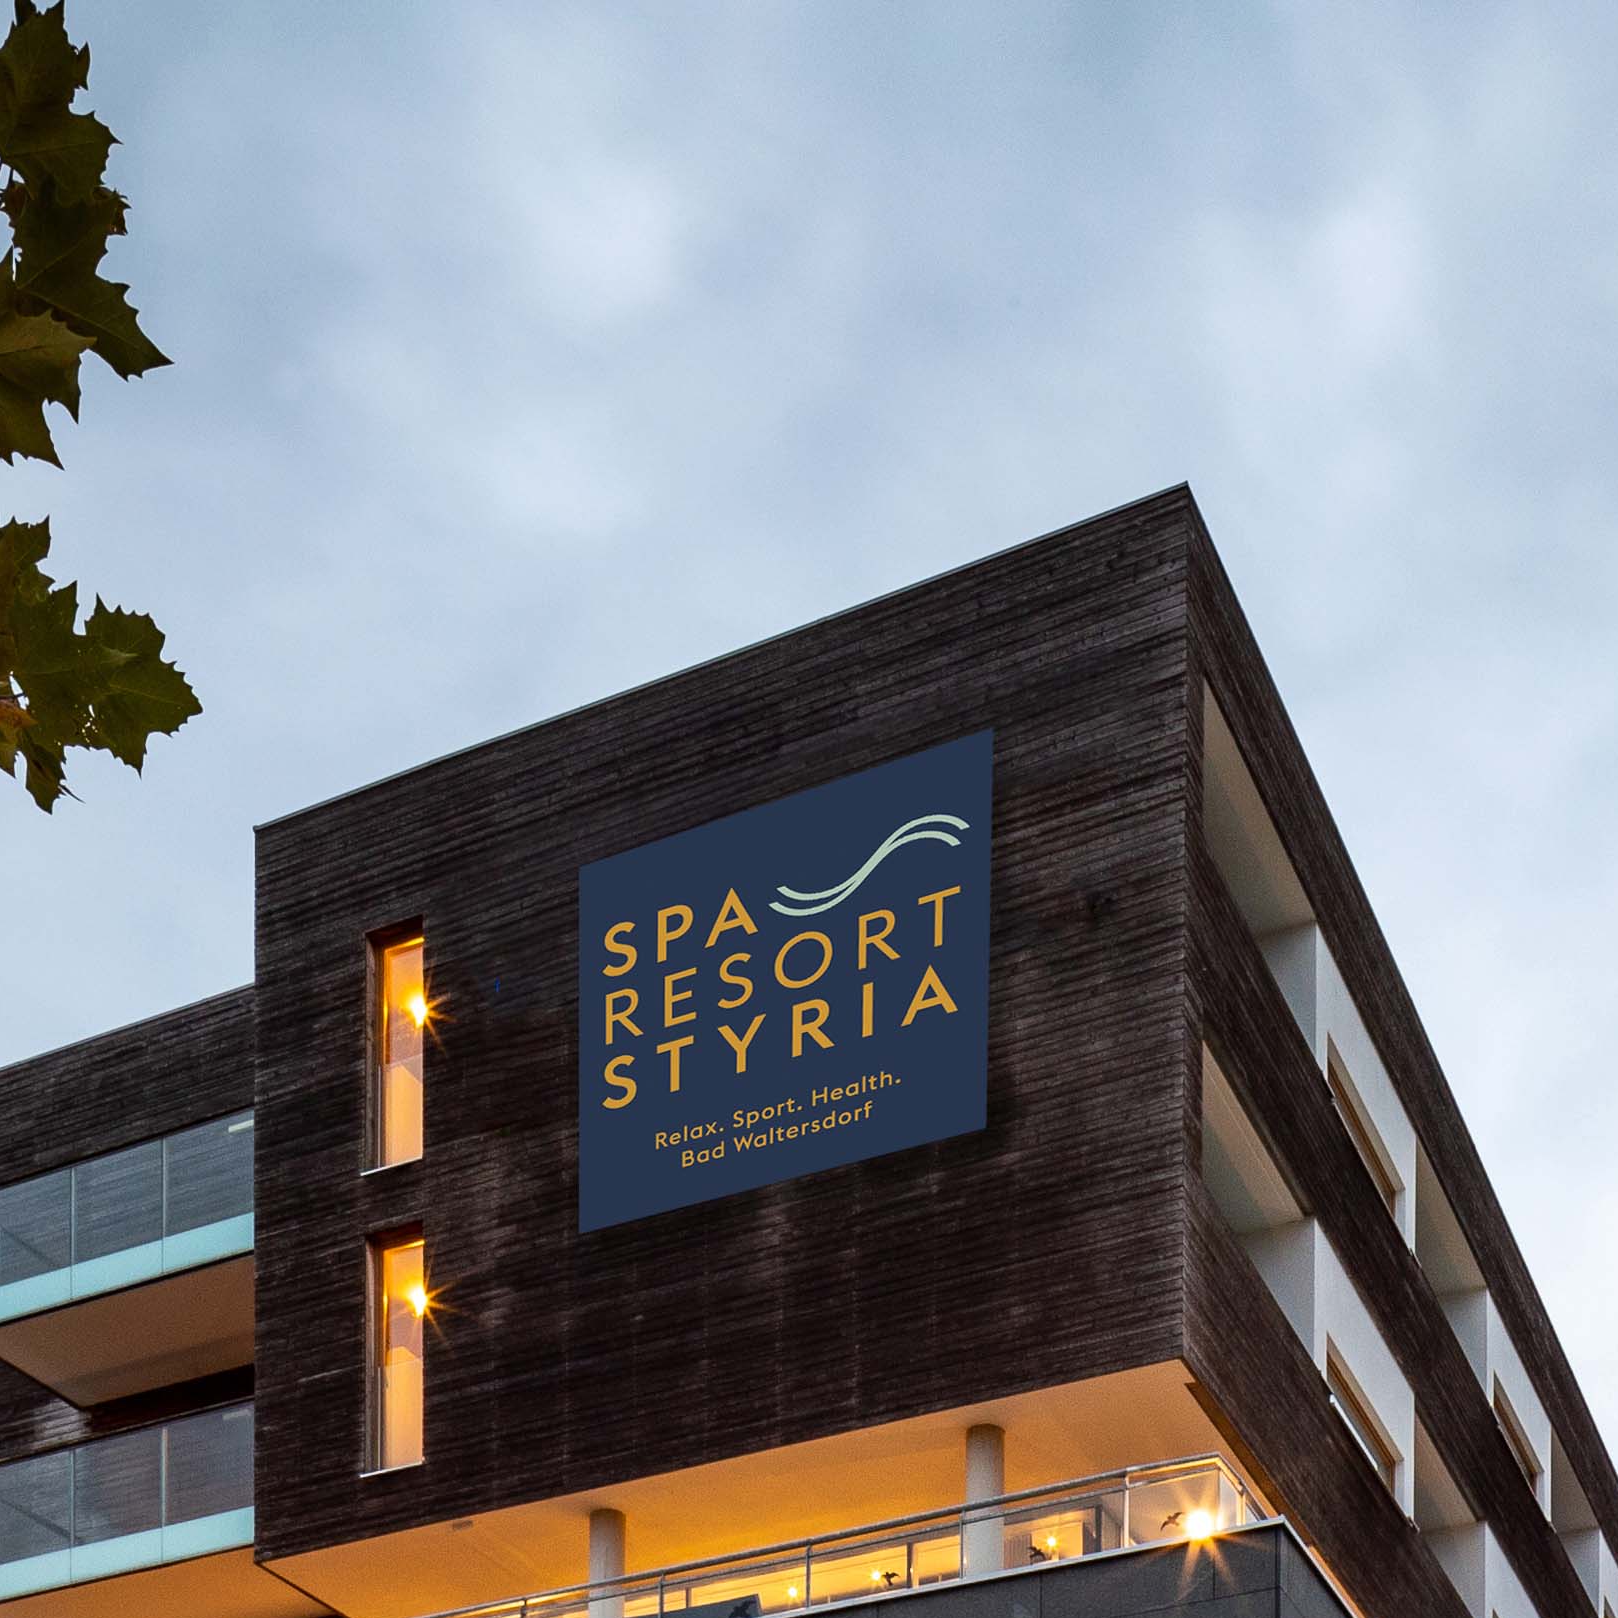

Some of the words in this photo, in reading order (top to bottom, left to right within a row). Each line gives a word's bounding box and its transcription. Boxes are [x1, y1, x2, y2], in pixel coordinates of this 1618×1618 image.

[602, 887, 759, 977] SPA
[605, 885, 962, 1046] RESORT
[602, 964, 959, 1110] STYRIA
[655, 1125, 725, 1151] Relax.
[733, 1097, 803, 1130] Sport.
[811, 1071, 902, 1107] Health.
[681, 1141, 726, 1169] Bad
[733, 1100, 874, 1154] Waltersdorf
